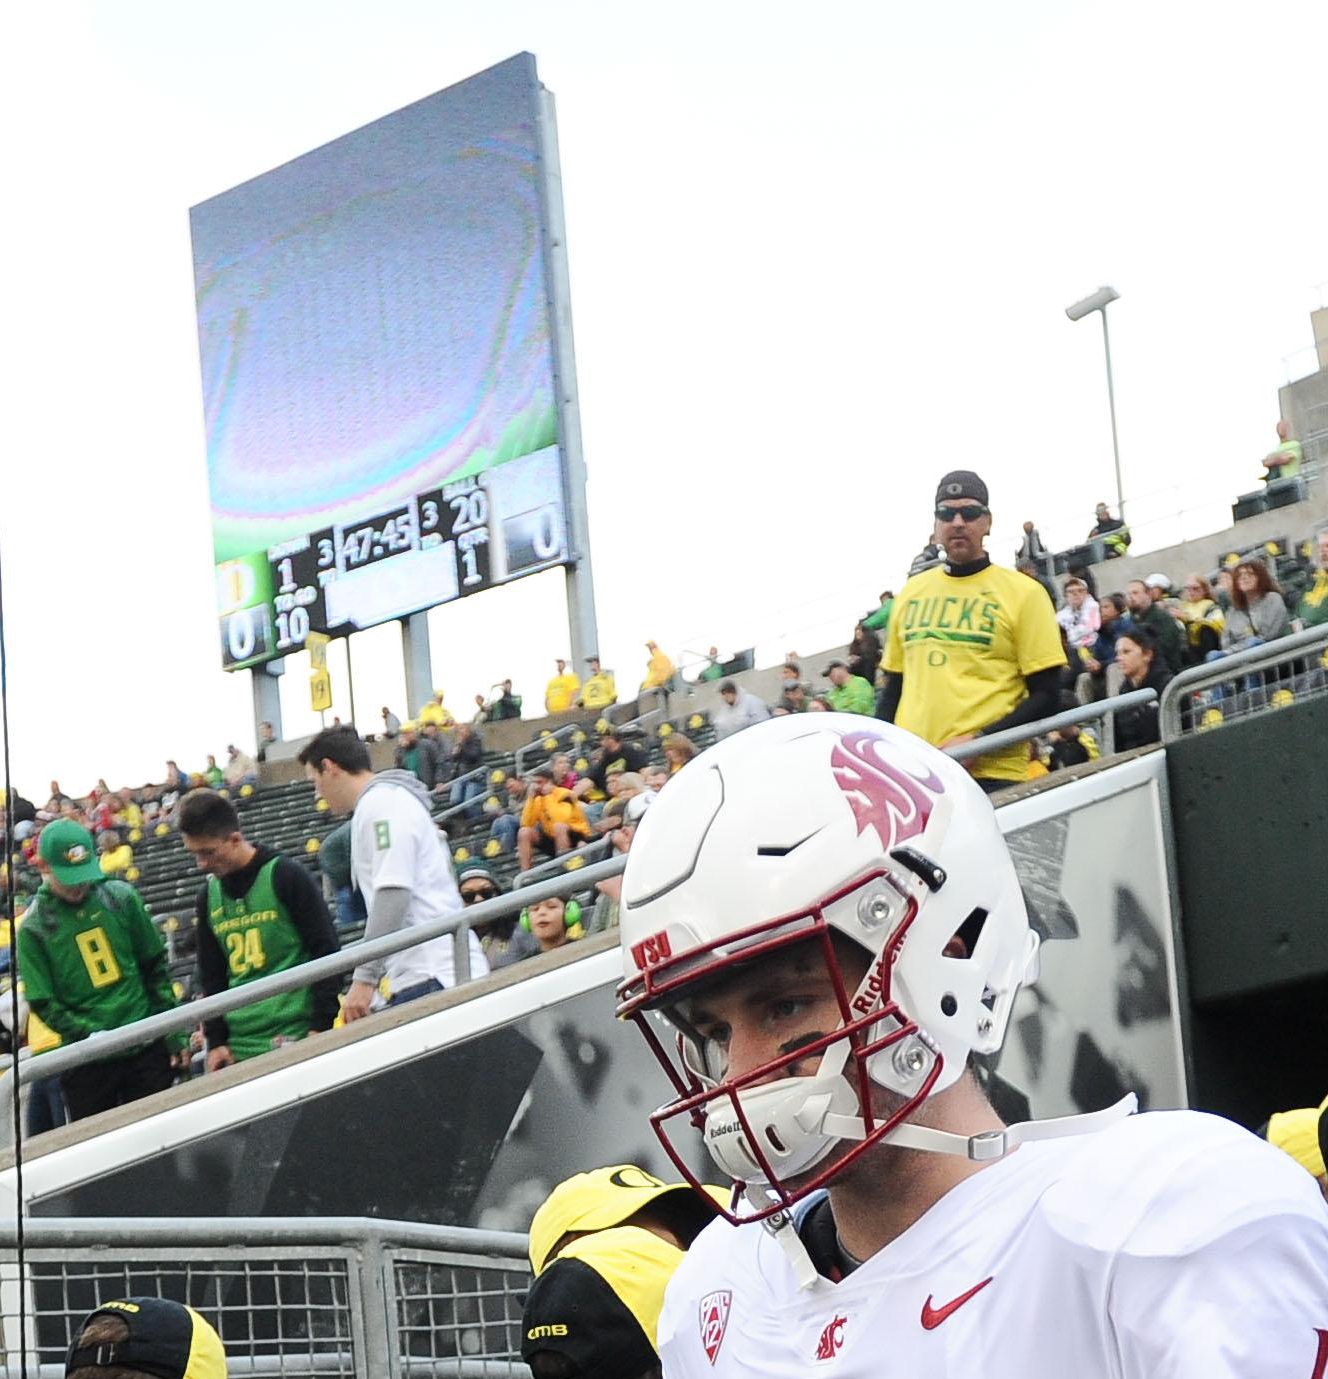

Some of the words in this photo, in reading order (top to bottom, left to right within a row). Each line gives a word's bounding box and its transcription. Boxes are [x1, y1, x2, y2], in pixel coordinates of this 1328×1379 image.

[421, 500, 439, 529] 3
[449, 489, 489, 534] 20
[532, 502, 561, 559] 0
[317, 538, 334, 567] 3
[342, 512, 412, 566] 47:45
[277, 557, 298, 593] 1
[461, 549, 483, 586] 1
[275, 606, 310, 649] 10
[902, 595, 1000, 631] DUCKS
[228, 612, 257, 661] 0
[374, 819, 391, 852] 8
[74, 925, 121, 991] 8
[225, 927, 268, 976] 24
[630, 929, 672, 971] WSU
